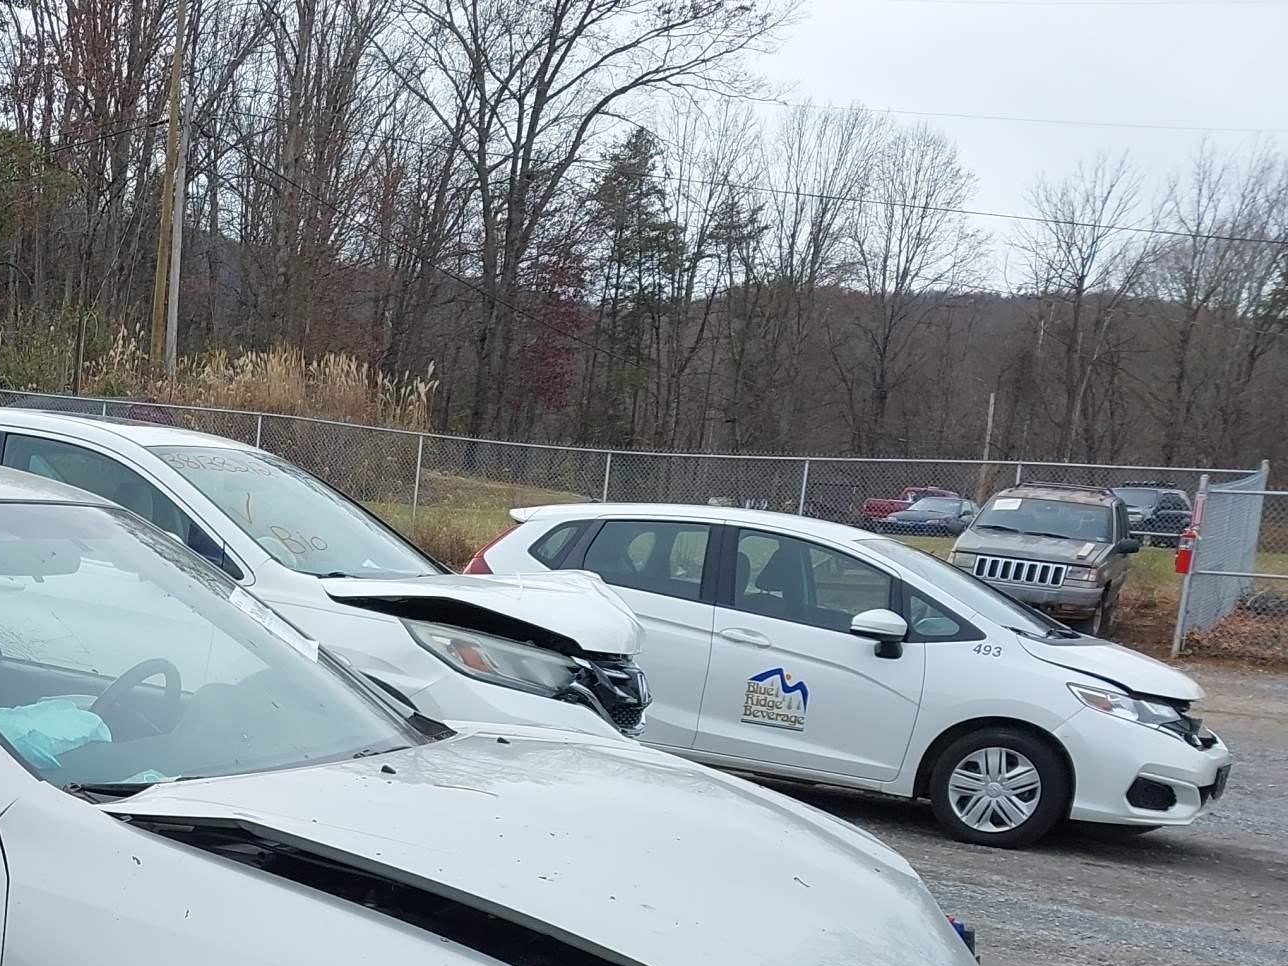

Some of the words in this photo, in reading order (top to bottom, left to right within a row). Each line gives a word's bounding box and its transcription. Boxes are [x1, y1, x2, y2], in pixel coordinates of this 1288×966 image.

[269, 525, 328, 554] Bio
[972, 643, 1002, 657] 493
[745, 681, 774, 697] Blue
[744, 693, 783, 711] Ridge
[742, 704, 805, 726] Beverage
